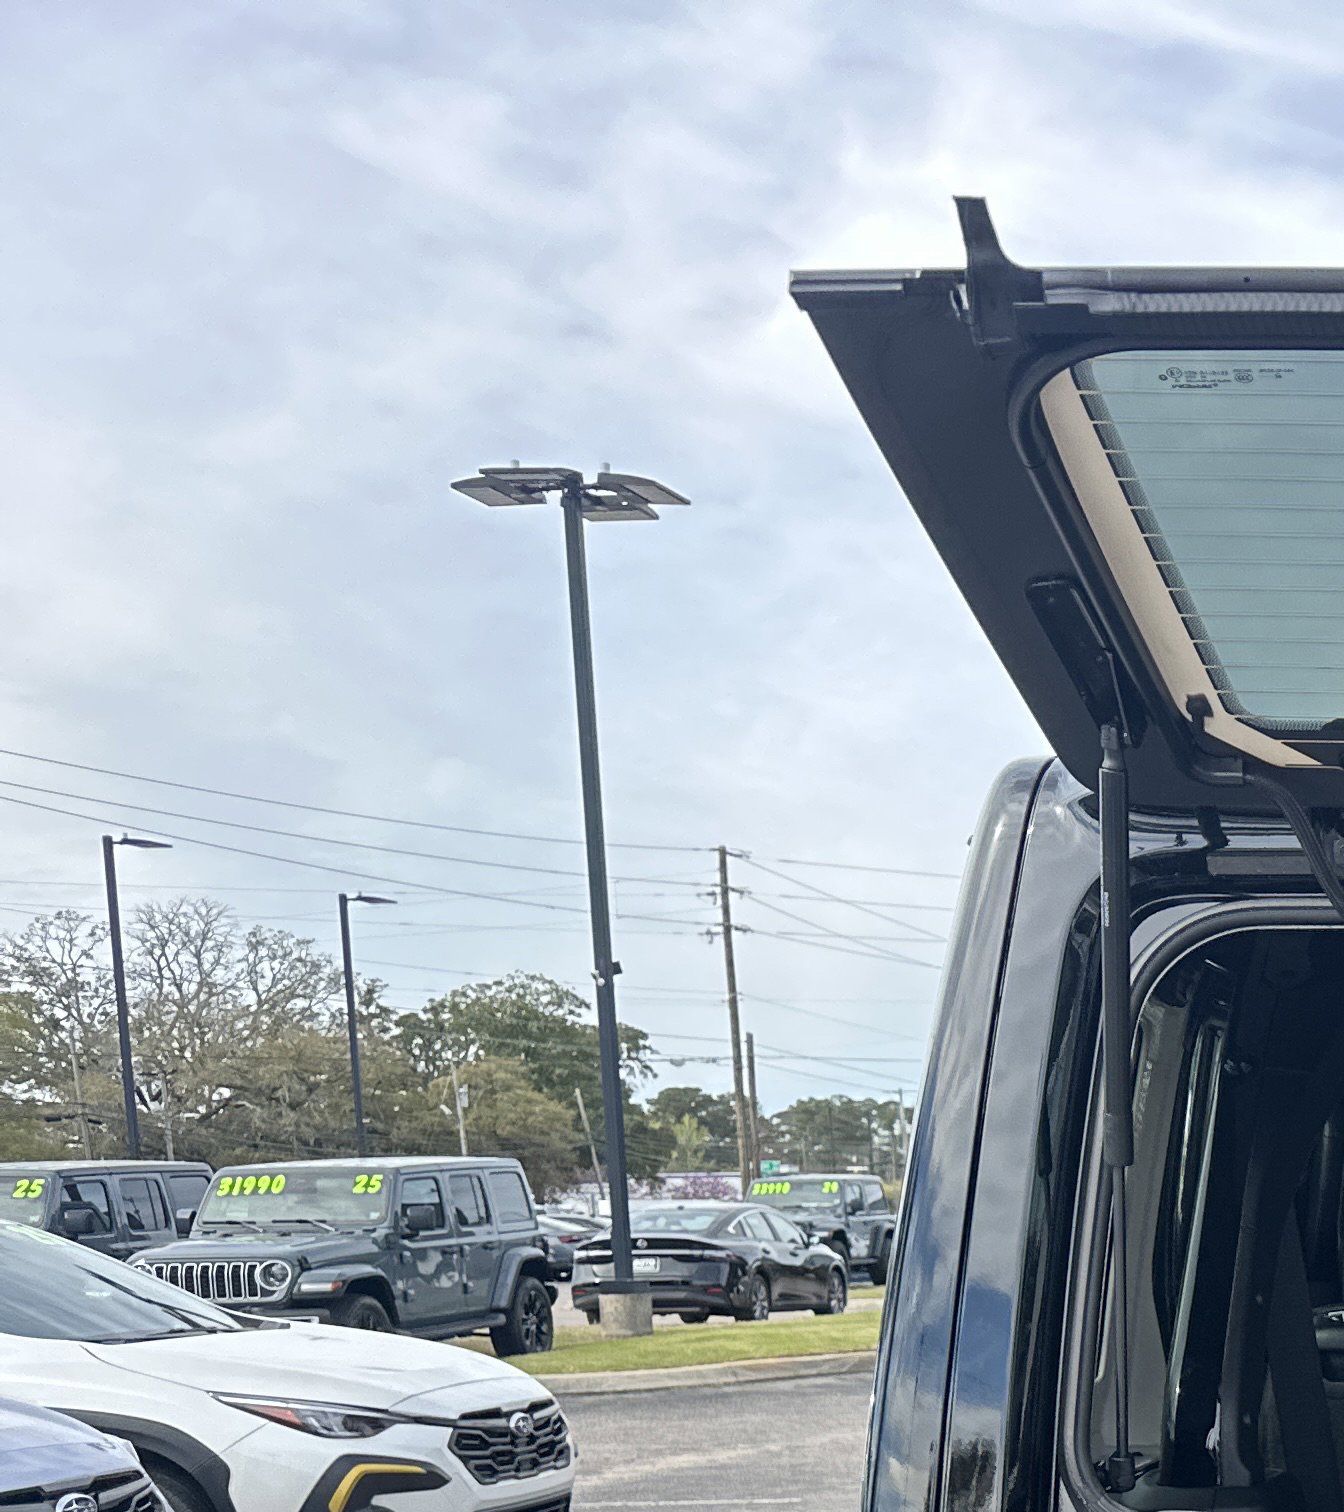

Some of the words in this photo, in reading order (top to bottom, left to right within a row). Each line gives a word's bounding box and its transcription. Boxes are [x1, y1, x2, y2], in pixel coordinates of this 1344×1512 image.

[12, 1178, 46, 1199] 25
[216, 1174, 286, 1197] 31990
[352, 1174, 384, 1194] 25
